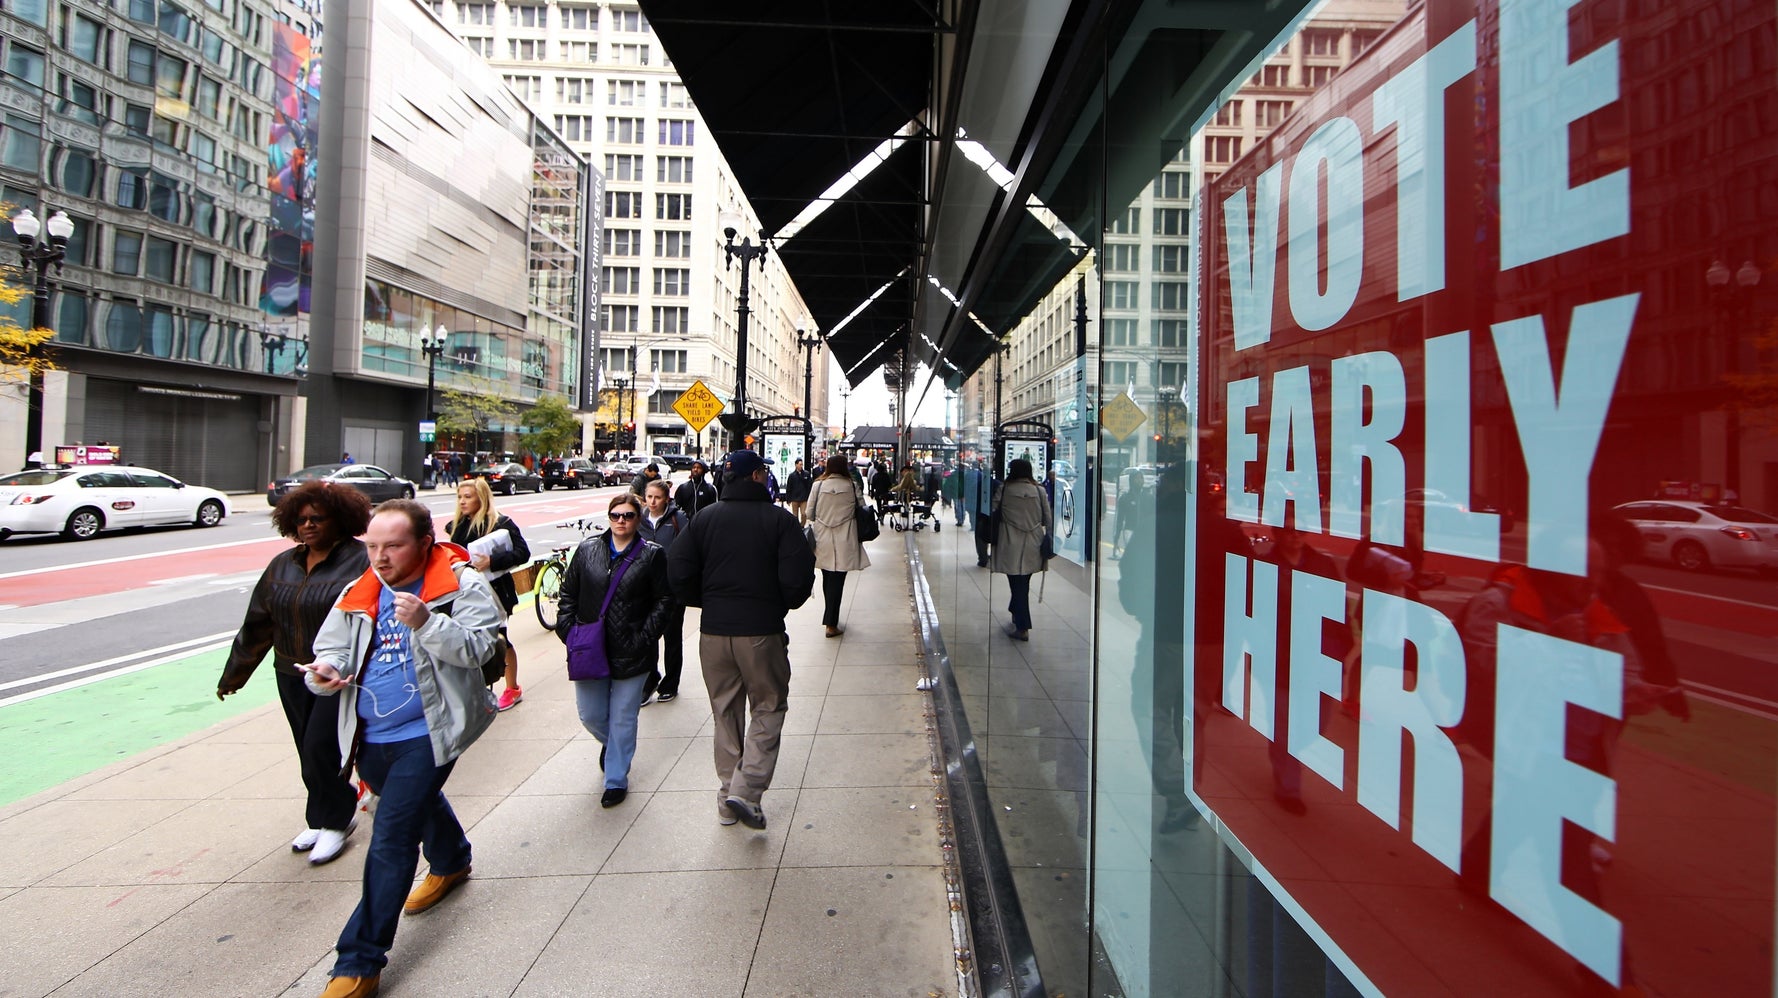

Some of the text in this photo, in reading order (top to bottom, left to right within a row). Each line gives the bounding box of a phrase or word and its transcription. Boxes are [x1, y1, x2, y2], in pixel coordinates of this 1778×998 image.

[590, 174, 602, 322] BLOCK THIRTY SEVEN
[1223, 0, 1630, 351] VOTE
[1226, 293, 1641, 577] EARLY
[1222, 551, 1624, 989] HERE
